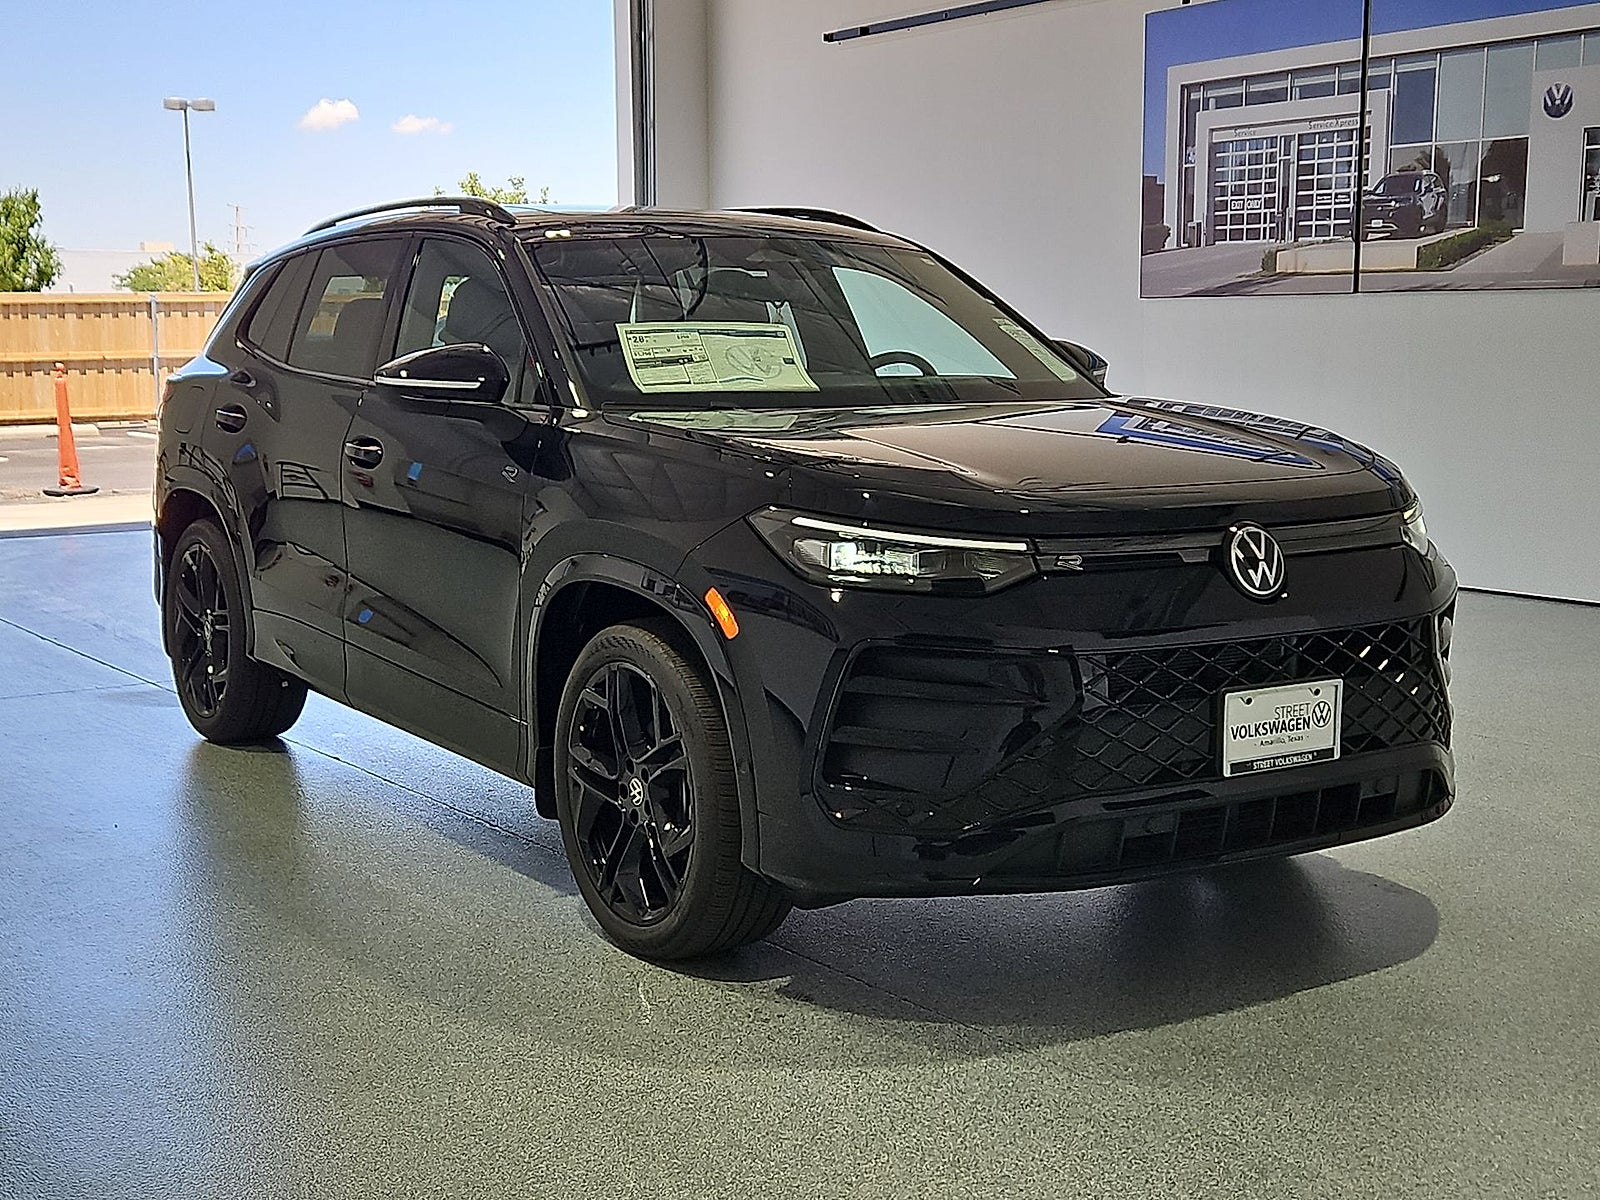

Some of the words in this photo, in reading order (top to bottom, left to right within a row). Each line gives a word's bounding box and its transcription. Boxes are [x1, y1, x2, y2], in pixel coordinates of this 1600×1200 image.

[1308, 120, 1334, 130] Service
[1234, 128, 1256, 138] Service
[1231, 200, 1243, 210] EXIT
[1246, 199, 1262, 209] ONLY
[1274, 702, 1311, 720] STREET
[1230, 715, 1311, 740] VOLKSWAGEN
[1287, 735, 1304, 743] Texas
[1252, 759, 1274, 770] STREET
[1275, 754, 1313, 767] VOLKSWAGEN
